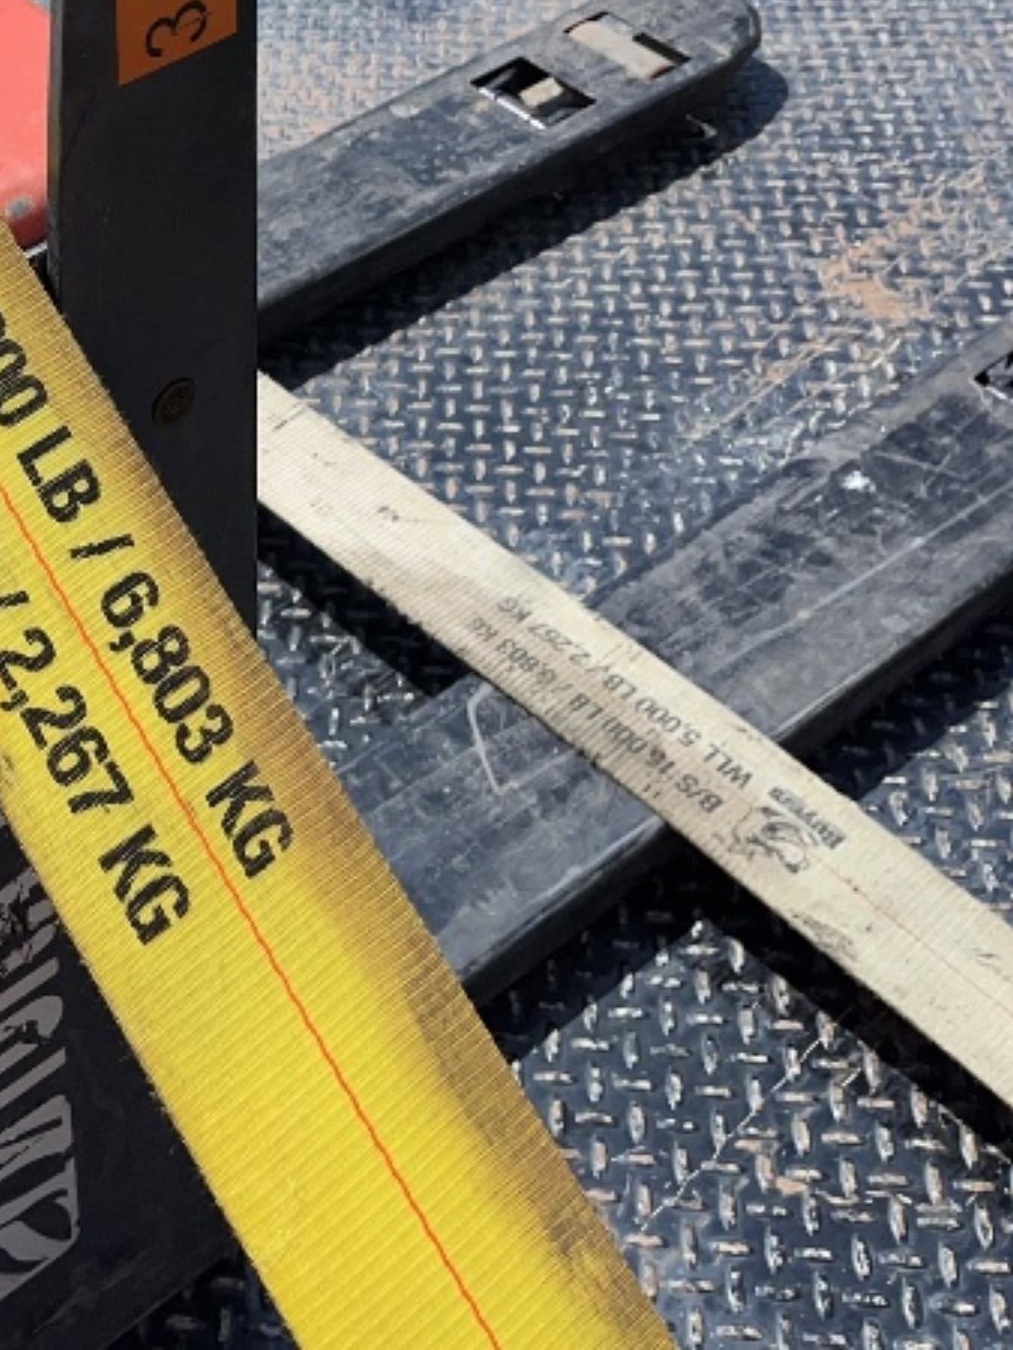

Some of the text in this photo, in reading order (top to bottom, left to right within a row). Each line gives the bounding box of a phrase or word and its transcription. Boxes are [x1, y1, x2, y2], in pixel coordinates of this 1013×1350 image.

[16, 425, 104, 524] LB
[69, 533, 136, 562] /
[99, 571, 234, 765] 6,803
[206, 759, 294, 879] KG
[703, 743, 754, 790] WLL
[98, 824, 192, 947] KG
